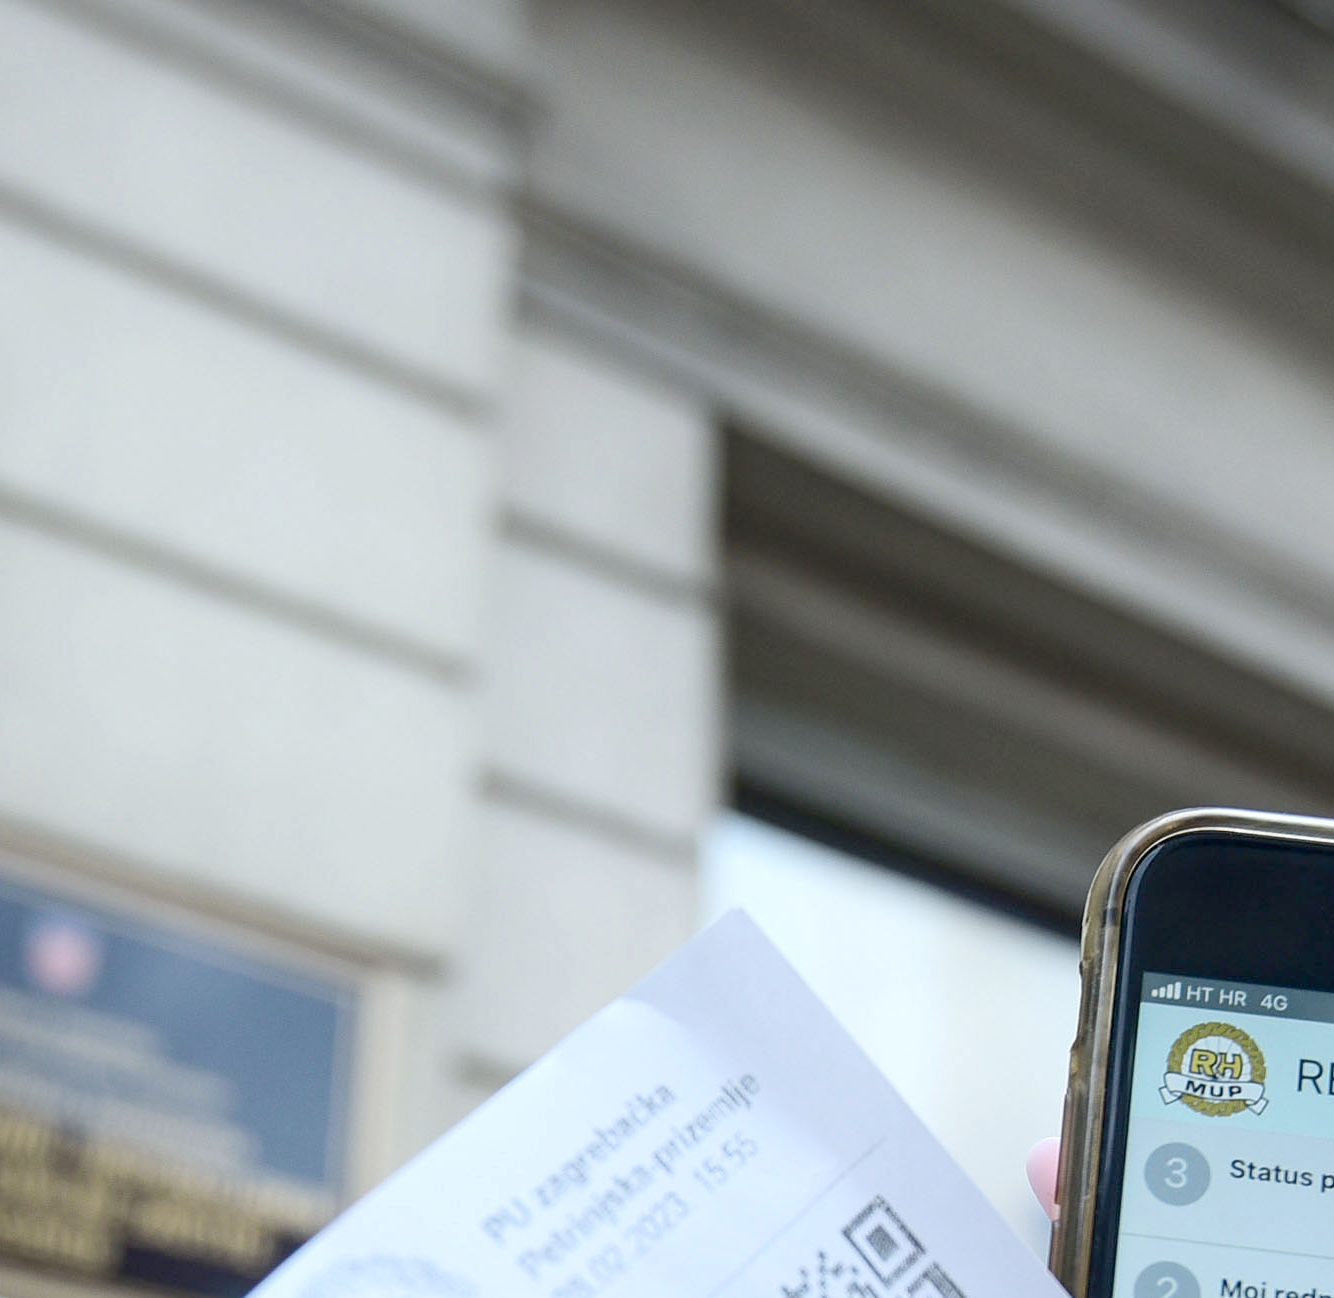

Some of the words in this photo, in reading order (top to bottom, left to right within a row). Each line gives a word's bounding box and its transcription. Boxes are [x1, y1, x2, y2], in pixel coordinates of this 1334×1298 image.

[1186, 985, 1214, 1002] HT
[1218, 989, 1247, 1007] HR
[1260, 994, 1288, 1011] 4G
[1189, 1048, 1244, 1080] RH
[1185, 1080, 1242, 1099] MUP
[1164, 1157, 1188, 1189] 3
[1230, 1159, 1313, 1187] Status
[481, 1197, 532, 1246] PU
